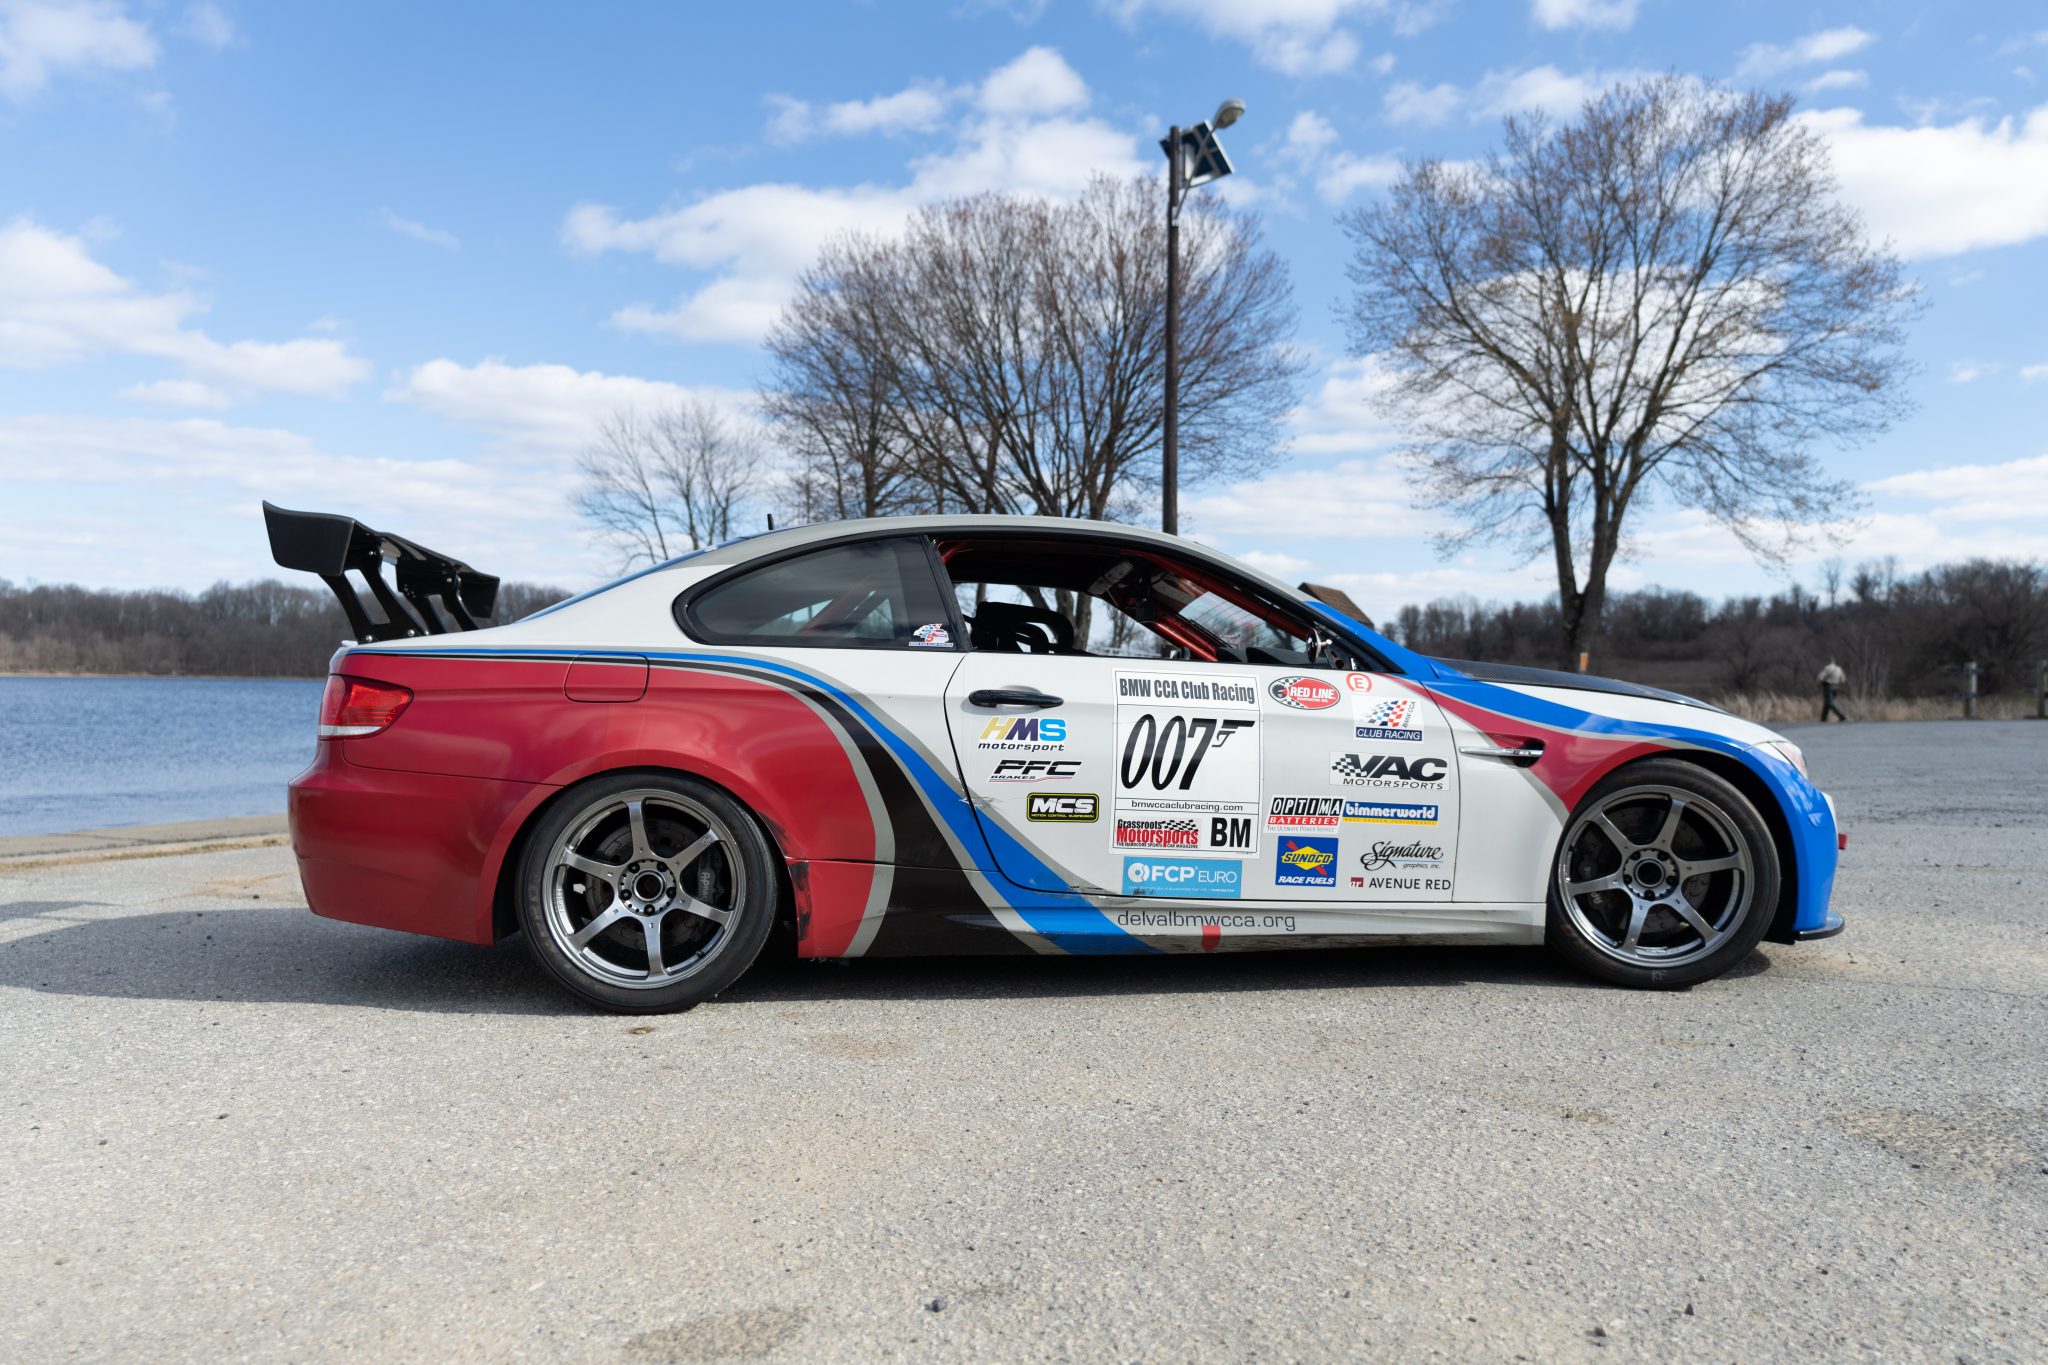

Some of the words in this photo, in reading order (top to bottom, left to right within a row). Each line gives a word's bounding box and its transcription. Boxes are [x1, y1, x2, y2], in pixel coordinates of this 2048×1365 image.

[1120, 678, 1151, 697] BMW
[1154, 679, 1179, 699] CCA
[1181, 681, 1210, 700] Club
[1212, 682, 1256, 704] Racing
[1354, 677, 1365, 689] E
[1290, 686, 1310, 698] RED
[1312, 688, 1335, 700] LINE
[1402, 713, 1412, 728] BMW
[980, 716, 1066, 742] HMS
[1357, 728, 1383, 738] CLUB
[1384, 730, 1421, 740] RACING
[978, 742, 1065, 753] motorsport
[1121, 714, 1217, 790] 007
[993, 759, 1082, 776] PFC
[1344, 753, 1448, 782] VAC
[1342, 778, 1443, 791] MOTORSPORTS
[1031, 797, 1095, 814] MCS
[1131, 800, 1243, 812] bmwccaclubracing.com
[1271, 798, 1343, 815] OPTIMA
[1346, 803, 1436, 819] bimmerworld
[1117, 819, 1163, 830] Grassroots
[1269, 816, 1338, 825] BATTERIES
[1116, 826, 1199, 847] Motorsports
[1210, 817, 1252, 848] BM
[1284, 853, 1331, 863] SUNOCO
[1360, 840, 1444, 871] Signature
[1151, 865, 1196, 883] FCP
[1198, 870, 1238, 884] EURO
[1278, 875, 1304, 884] RACE
[1305, 876, 1335, 885] FUELS
[1369, 877, 1421, 890] AVENUE
[1425, 879, 1452, 890] RED
[1117, 910, 1296, 932] delvalbmwcca.org
